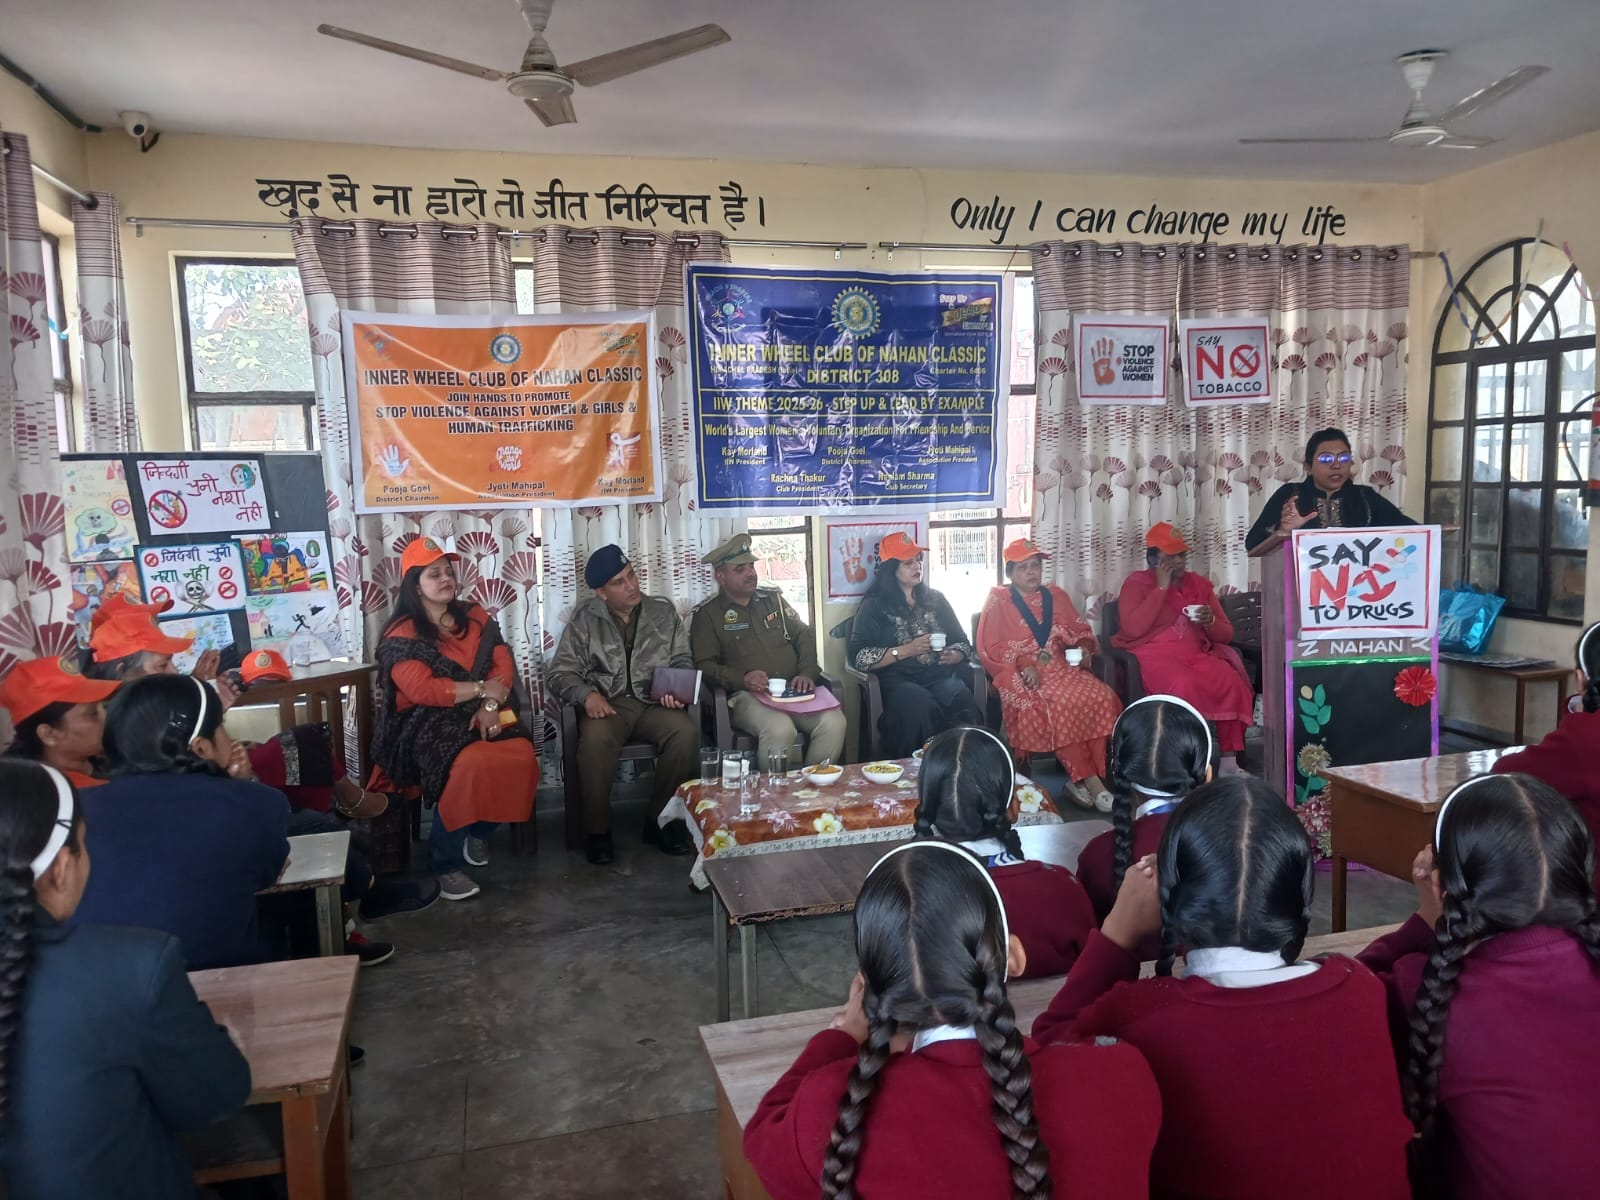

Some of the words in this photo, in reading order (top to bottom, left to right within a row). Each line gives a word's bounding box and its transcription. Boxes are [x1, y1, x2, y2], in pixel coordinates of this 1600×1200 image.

[256, 178, 321, 219] खुद
[327, 174, 361, 214] से
[373, 185, 413, 215] ना
[427, 178, 487, 221] हारो
[495, 178, 525, 219] तो
[532, 178, 590, 221] जीत
[950, 195, 1015, 244] Only
[1028, 200, 1042, 232] I
[1056, 206, 1117, 233] can
[1126, 203, 1229, 242] change
[1241, 212, 1288, 244] my
[1302, 205, 1346, 244] life
[1197, 335, 1222, 347] SAY
[709, 344, 756, 362] INNER
[761, 344, 811, 362] WHEEL
[815, 345, 854, 363] CLUB
[858, 345, 875, 363] OF
[879, 345, 928, 363] NAHAN
[932, 346, 987, 363] CLASSIC
[1123, 345, 1155, 357] STOP
[1122, 365, 1154, 373] AGAINST
[1196, 344, 1261, 381] NO
[364, 369, 409, 385] INNER
[413, 371, 465, 386] WHEEL
[468, 372, 506, 386] CLUB
[511, 371, 528, 386] OF
[533, 370, 582, 385] NAHAN
[587, 367, 642, 382] CLASSIC
[807, 369, 871, 384] DISTRICT
[875, 369, 899, 383] 308
[930, 367, 956, 375] Charter
[1122, 373, 1154, 381] WOMEN
[1197, 381, 1262, 394] TOBACCO
[447, 393, 470, 402] JOIN
[473, 393, 507, 402] HANDS
[510, 393, 521, 402] TO
[525, 391, 570, 401] PROMOTE
[376, 406, 407, 418] STOP
[411, 406, 470, 417] VIOLENCE
[474, 405, 525, 417] AGAINST
[530, 404, 576, 416] WOMEN
[580, 402, 589, 414] &
[593, 402, 624, 414] GIRLS
[628, 402, 637, 412] &
[714, 397, 731, 410] IIW
[736, 396, 775, 411] THEME
[832, 396, 857, 410] STEP
[860, 397, 876, 410] UP
[879, 397, 887, 410] &
[890, 397, 918, 410] LEAD
[921, 397, 935, 410] BY
[938, 397, 985, 410] EXAMPLE
[448, 422, 494, 434] HUMAN
[498, 420, 574, 433] TRAFFICKING
[705, 424, 732, 436] World's
[735, 424, 767, 438] Largest
[846, 424, 893, 439] Organization
[895, 424, 908, 435] For
[910, 424, 947, 437] Friendship
[950, 423, 964, 434] And
[721, 447, 735, 458] Kay
[737, 446, 768, 456] Morland
[827, 446, 848, 457] Pooja
[615, 476, 645, 485] Morland
[800, 473, 826, 482] Thakur
[907, 471, 935, 481] Sharma
[383, 485, 408, 494] Pooja
[410, 484, 431, 492] Goel
[487, 482, 509, 491] Jyoti
[511, 481, 546, 490] Mahipal
[899, 483, 928, 491] Secretary
[212, 489, 246, 506] नशा
[1308, 537, 1383, 569] SAY
[1309, 604, 1341, 624] TO
[1347, 601, 1414, 621] DRUGS
[1330, 639, 1404, 655] NAHAN
